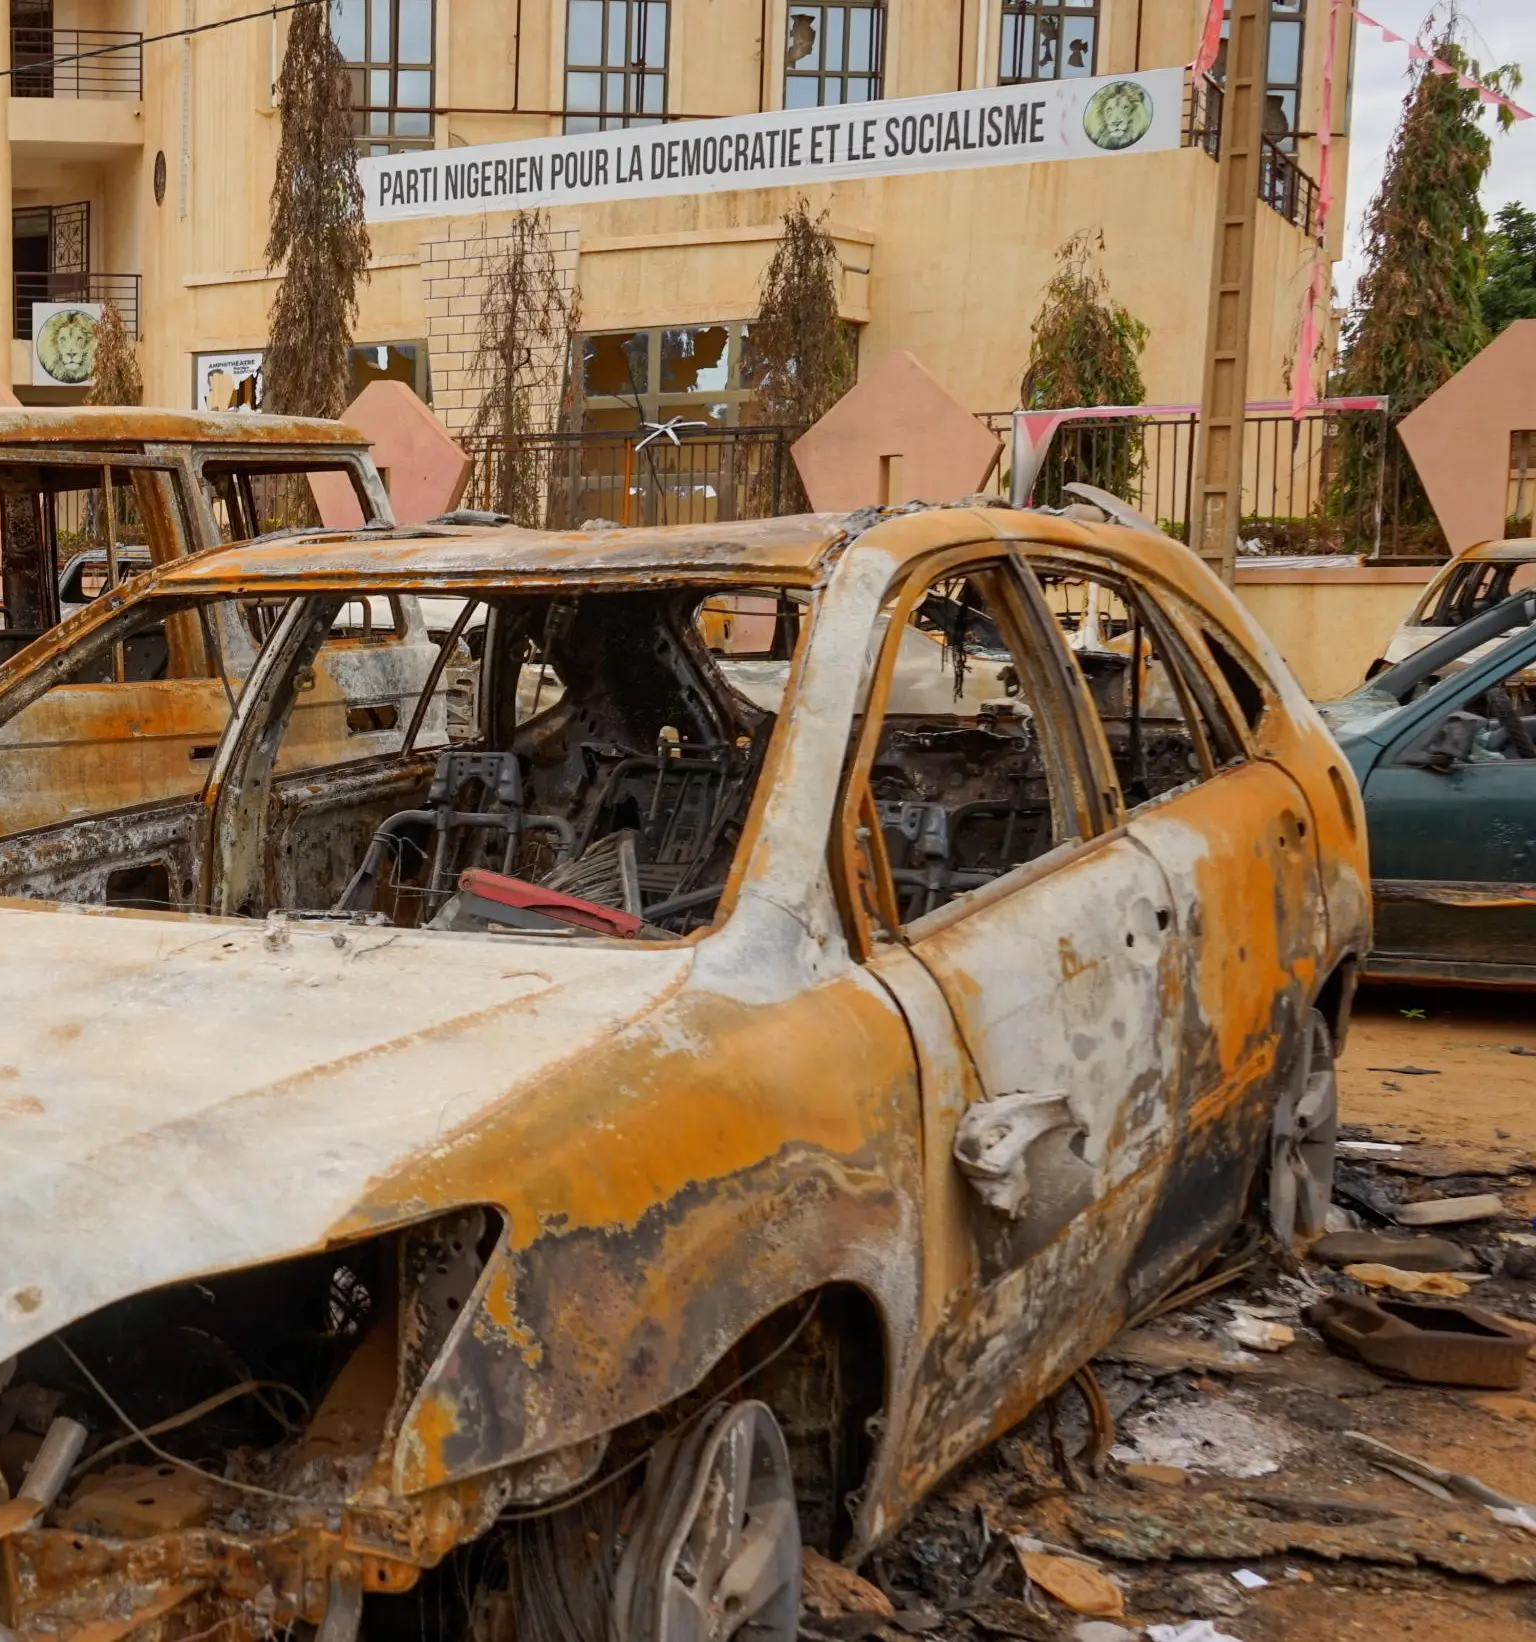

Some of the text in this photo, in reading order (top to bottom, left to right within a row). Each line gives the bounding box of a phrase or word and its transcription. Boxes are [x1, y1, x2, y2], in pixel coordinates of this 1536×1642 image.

[379, 101, 1046, 207] PARTI NIGERIEN POUR LA DEMOCRATIE ET LE SOCIALISME
